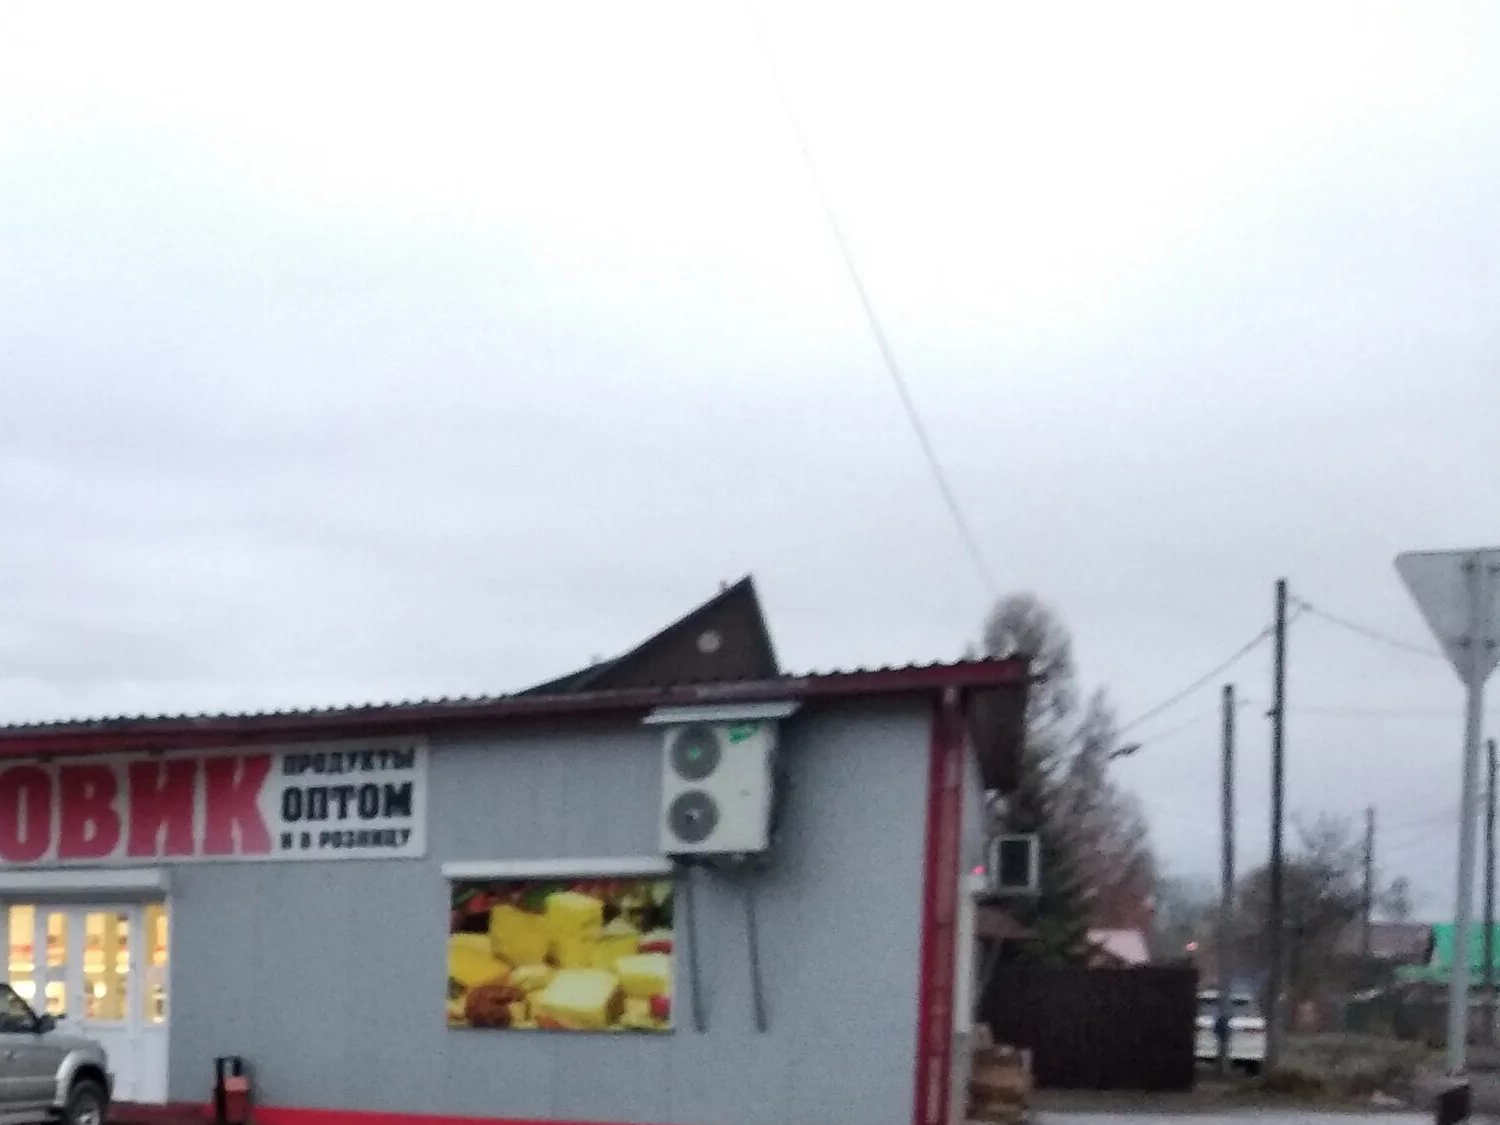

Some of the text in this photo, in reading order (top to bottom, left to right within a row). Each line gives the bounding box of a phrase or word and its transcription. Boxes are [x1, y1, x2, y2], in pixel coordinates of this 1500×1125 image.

[283, 747, 414, 776] ПРОДУКТЫ
[282, 782, 412, 822] ОПТОМ
[319, 828, 411, 848] РОЗНИЦУ
